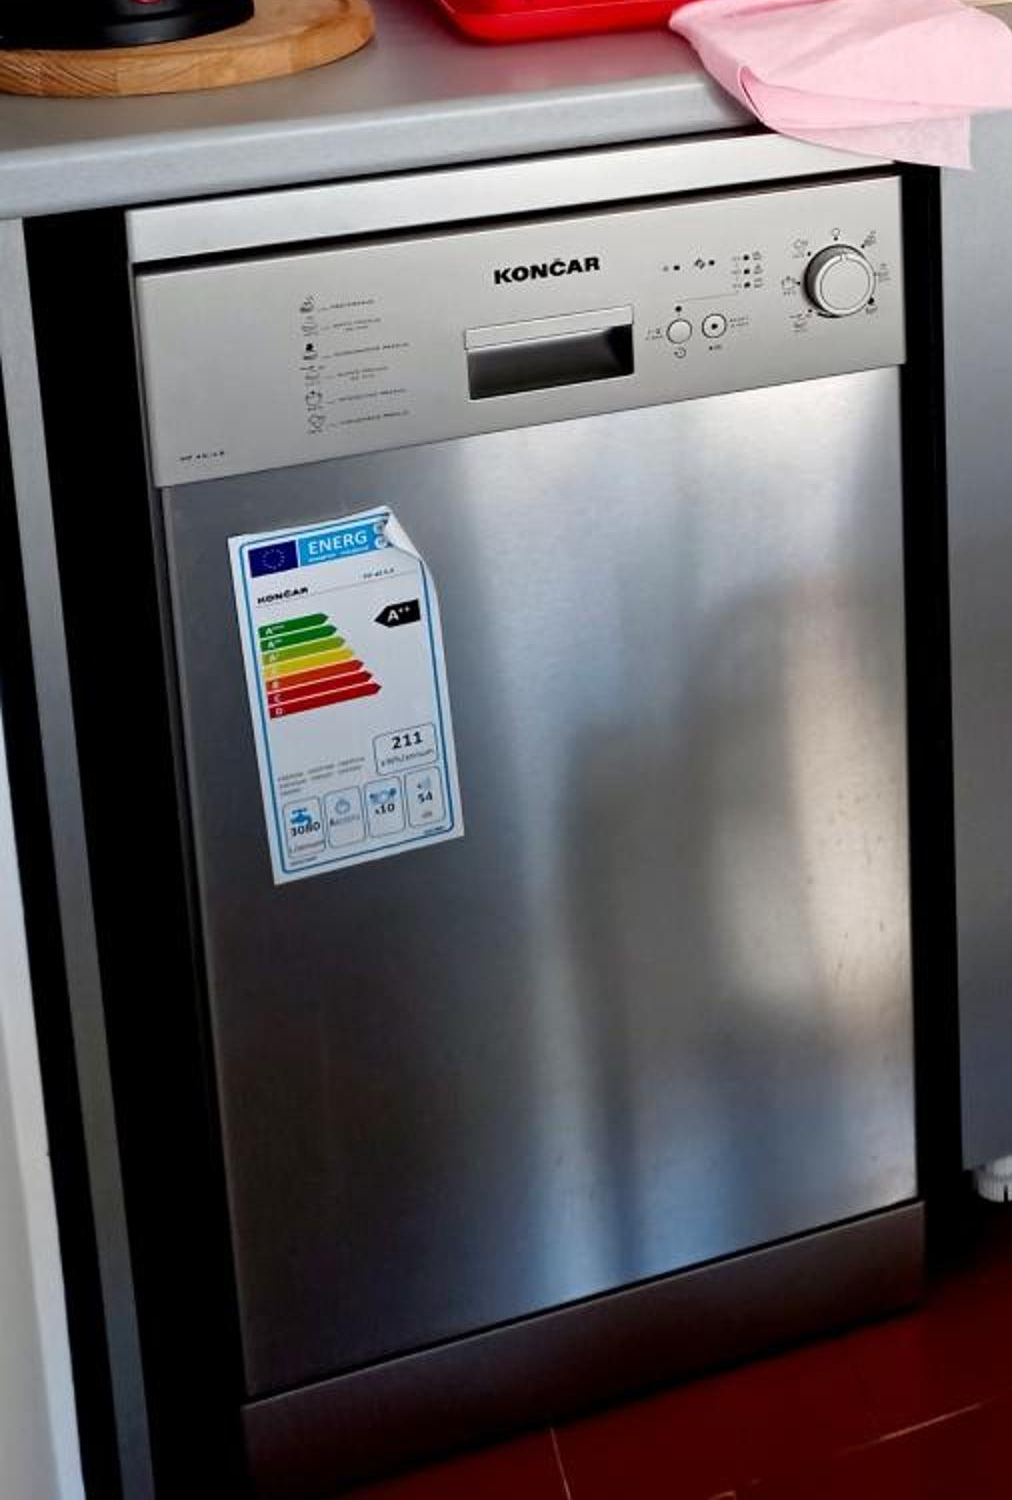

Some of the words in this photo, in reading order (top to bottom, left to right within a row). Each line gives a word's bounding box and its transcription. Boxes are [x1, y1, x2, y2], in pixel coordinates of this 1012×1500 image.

[308, 530, 368, 555] ENERG
[387, 605, 411, 622] A++
[391, 731, 423, 750] 211
